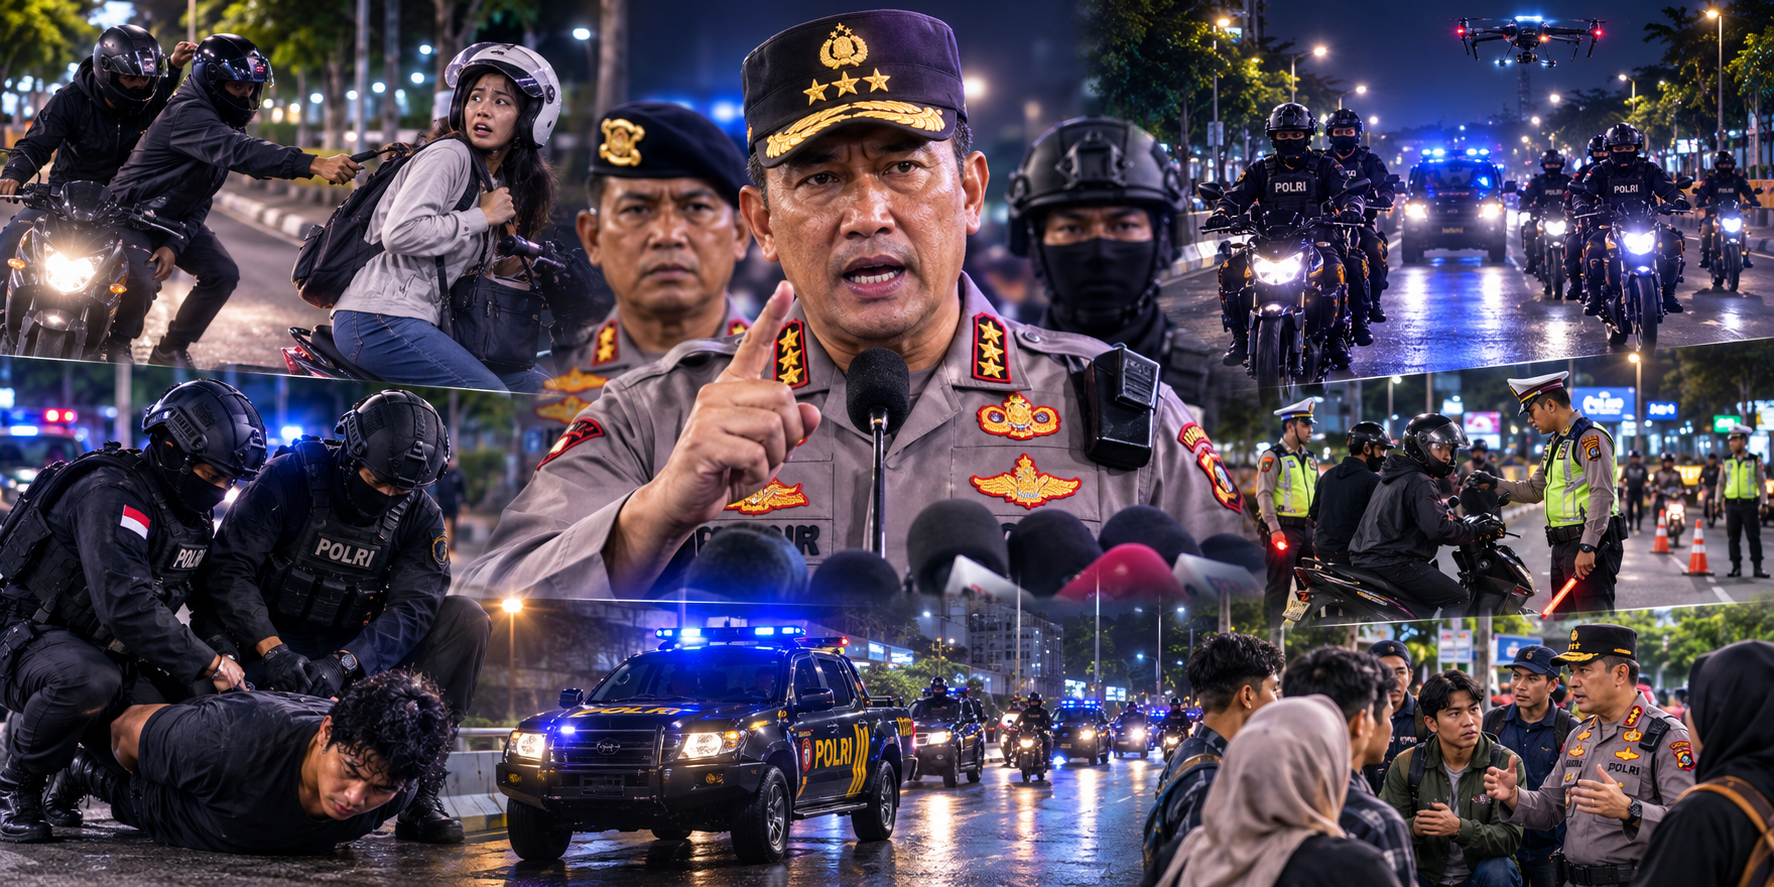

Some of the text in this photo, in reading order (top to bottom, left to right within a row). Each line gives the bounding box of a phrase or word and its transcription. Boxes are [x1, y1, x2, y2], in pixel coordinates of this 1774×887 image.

[1275, 181, 1307, 193] POLRI
[1614, 184, 1638, 194] POLRI
[172, 548, 207, 569] POLRI
[315, 538, 375, 567] POLRI
[567, 706, 683, 719] POLRI
[815, 737, 853, 769] POLRI
[1608, 762, 1640, 776] POLRI
